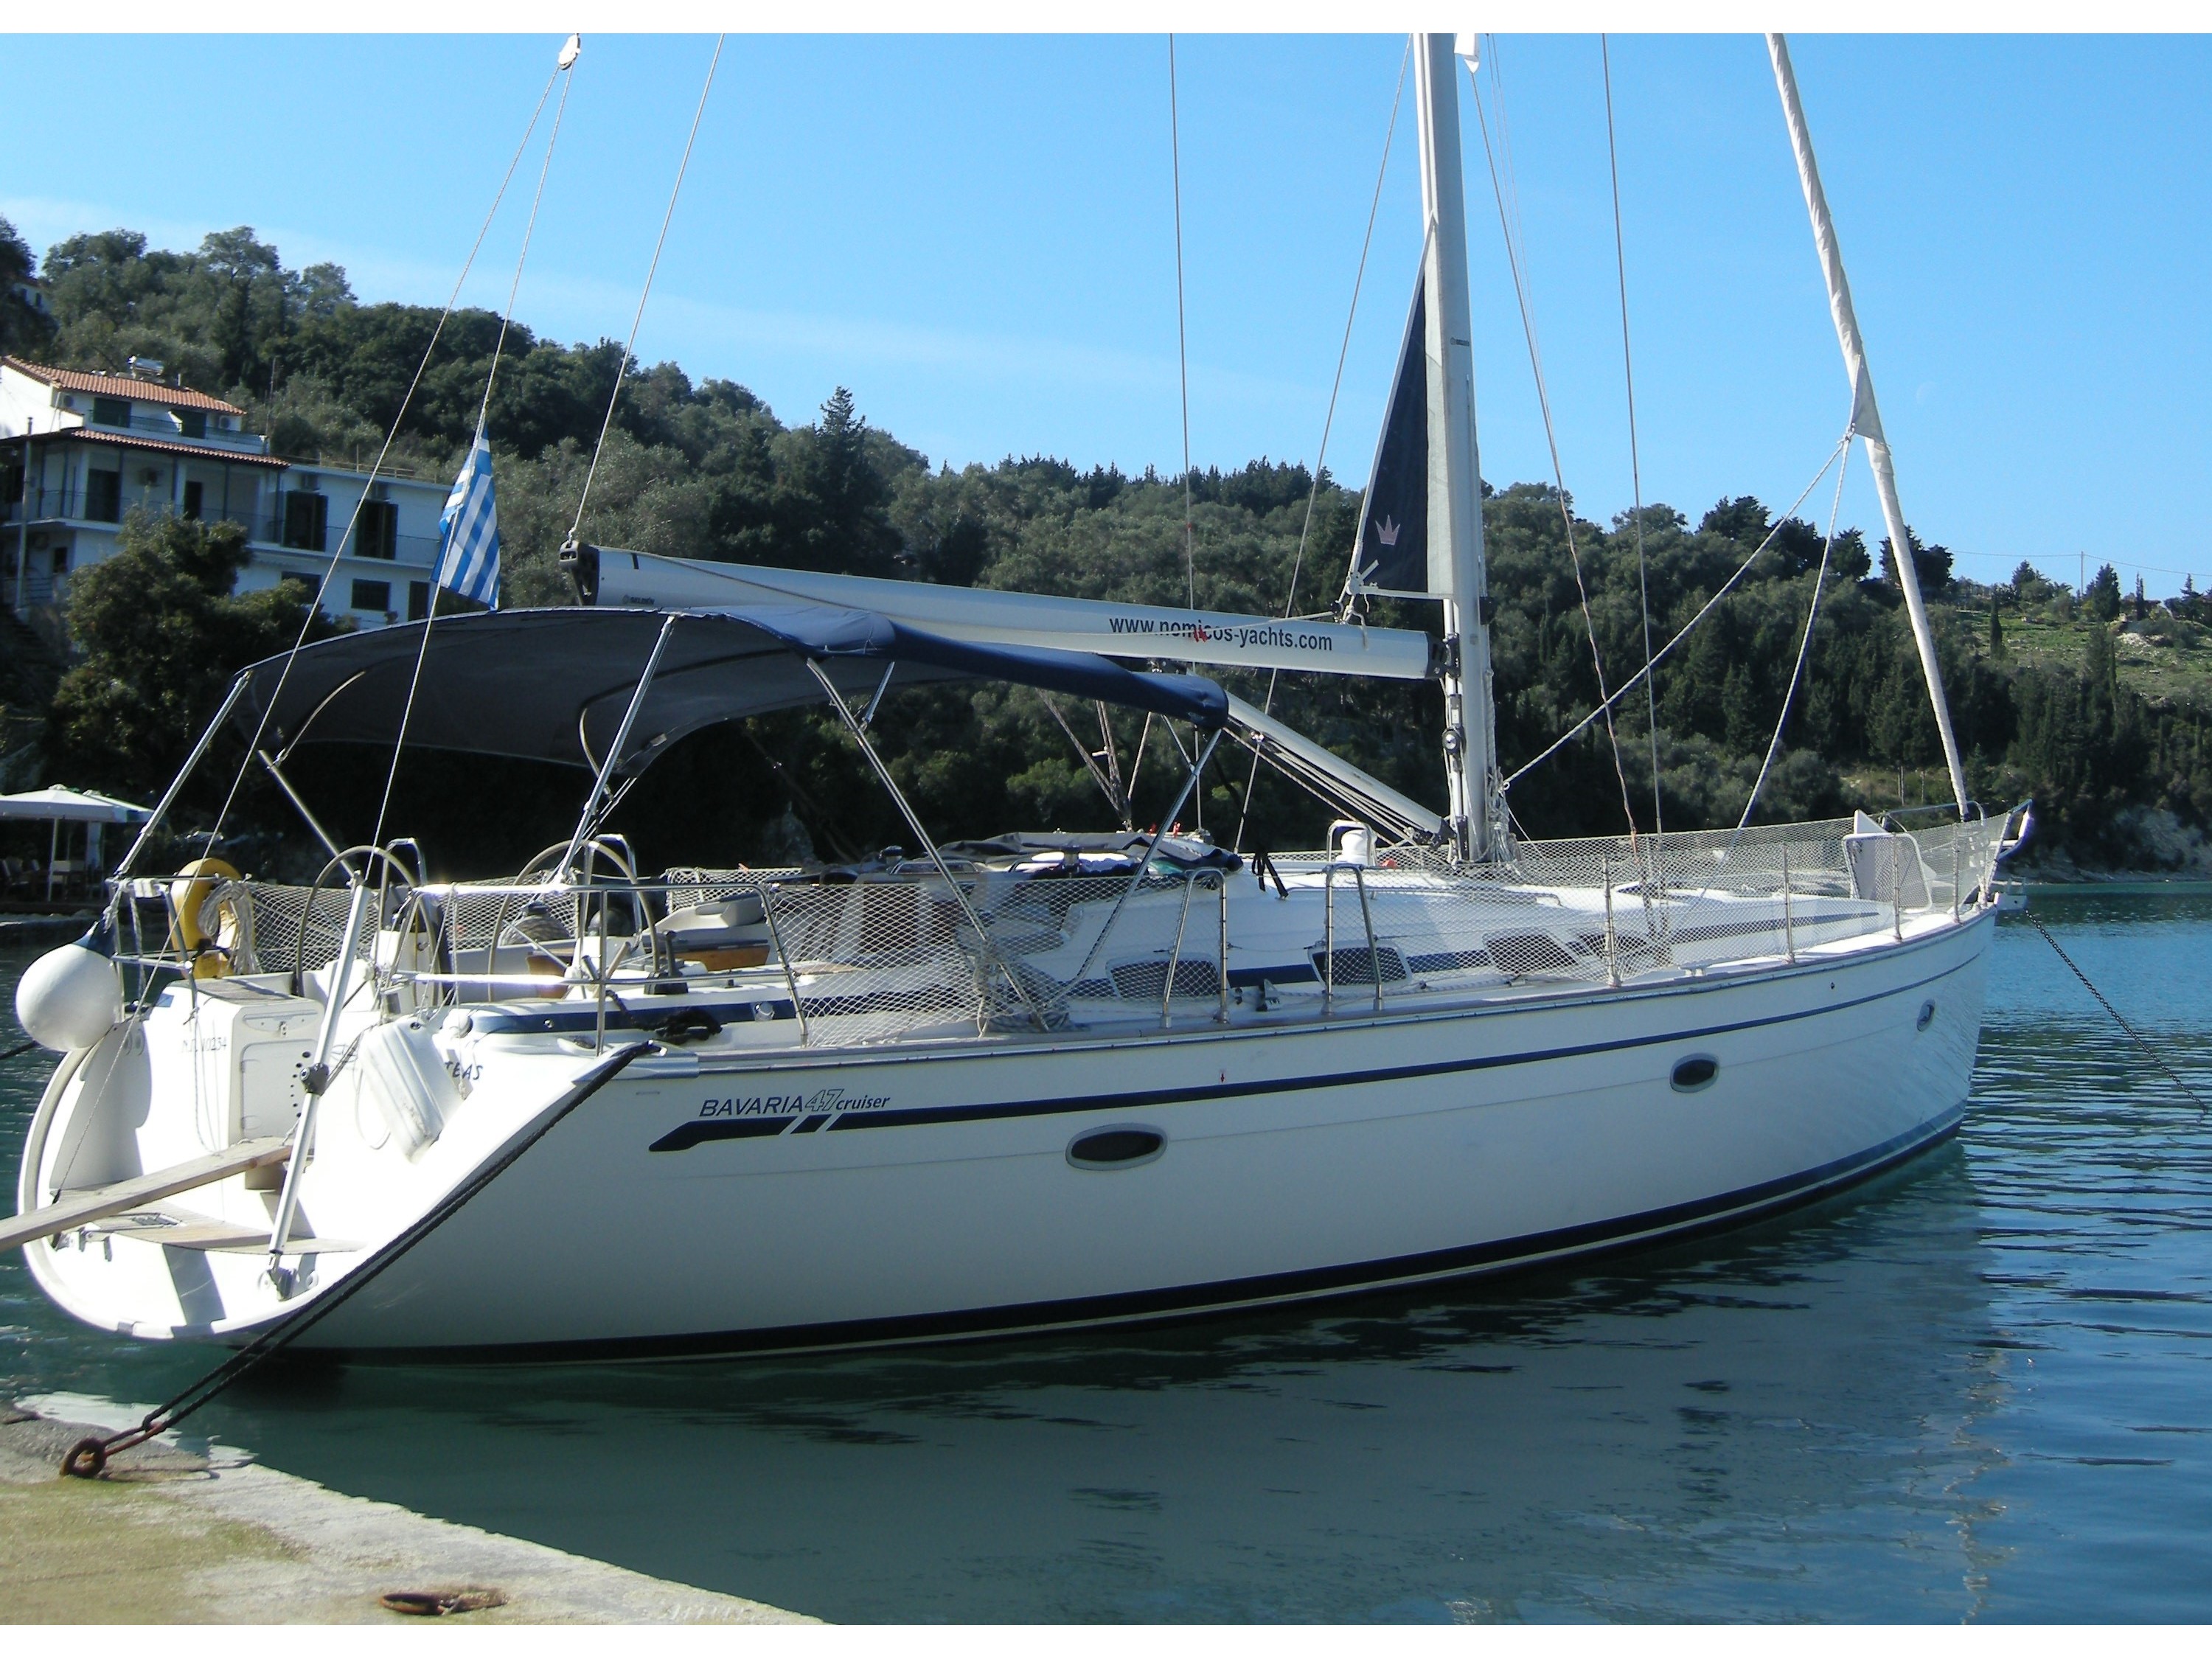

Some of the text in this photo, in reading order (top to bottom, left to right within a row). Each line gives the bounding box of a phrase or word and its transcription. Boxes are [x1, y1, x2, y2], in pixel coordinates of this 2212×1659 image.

[699, 1088, 891, 1117] BAVARIA 47 cruiser
